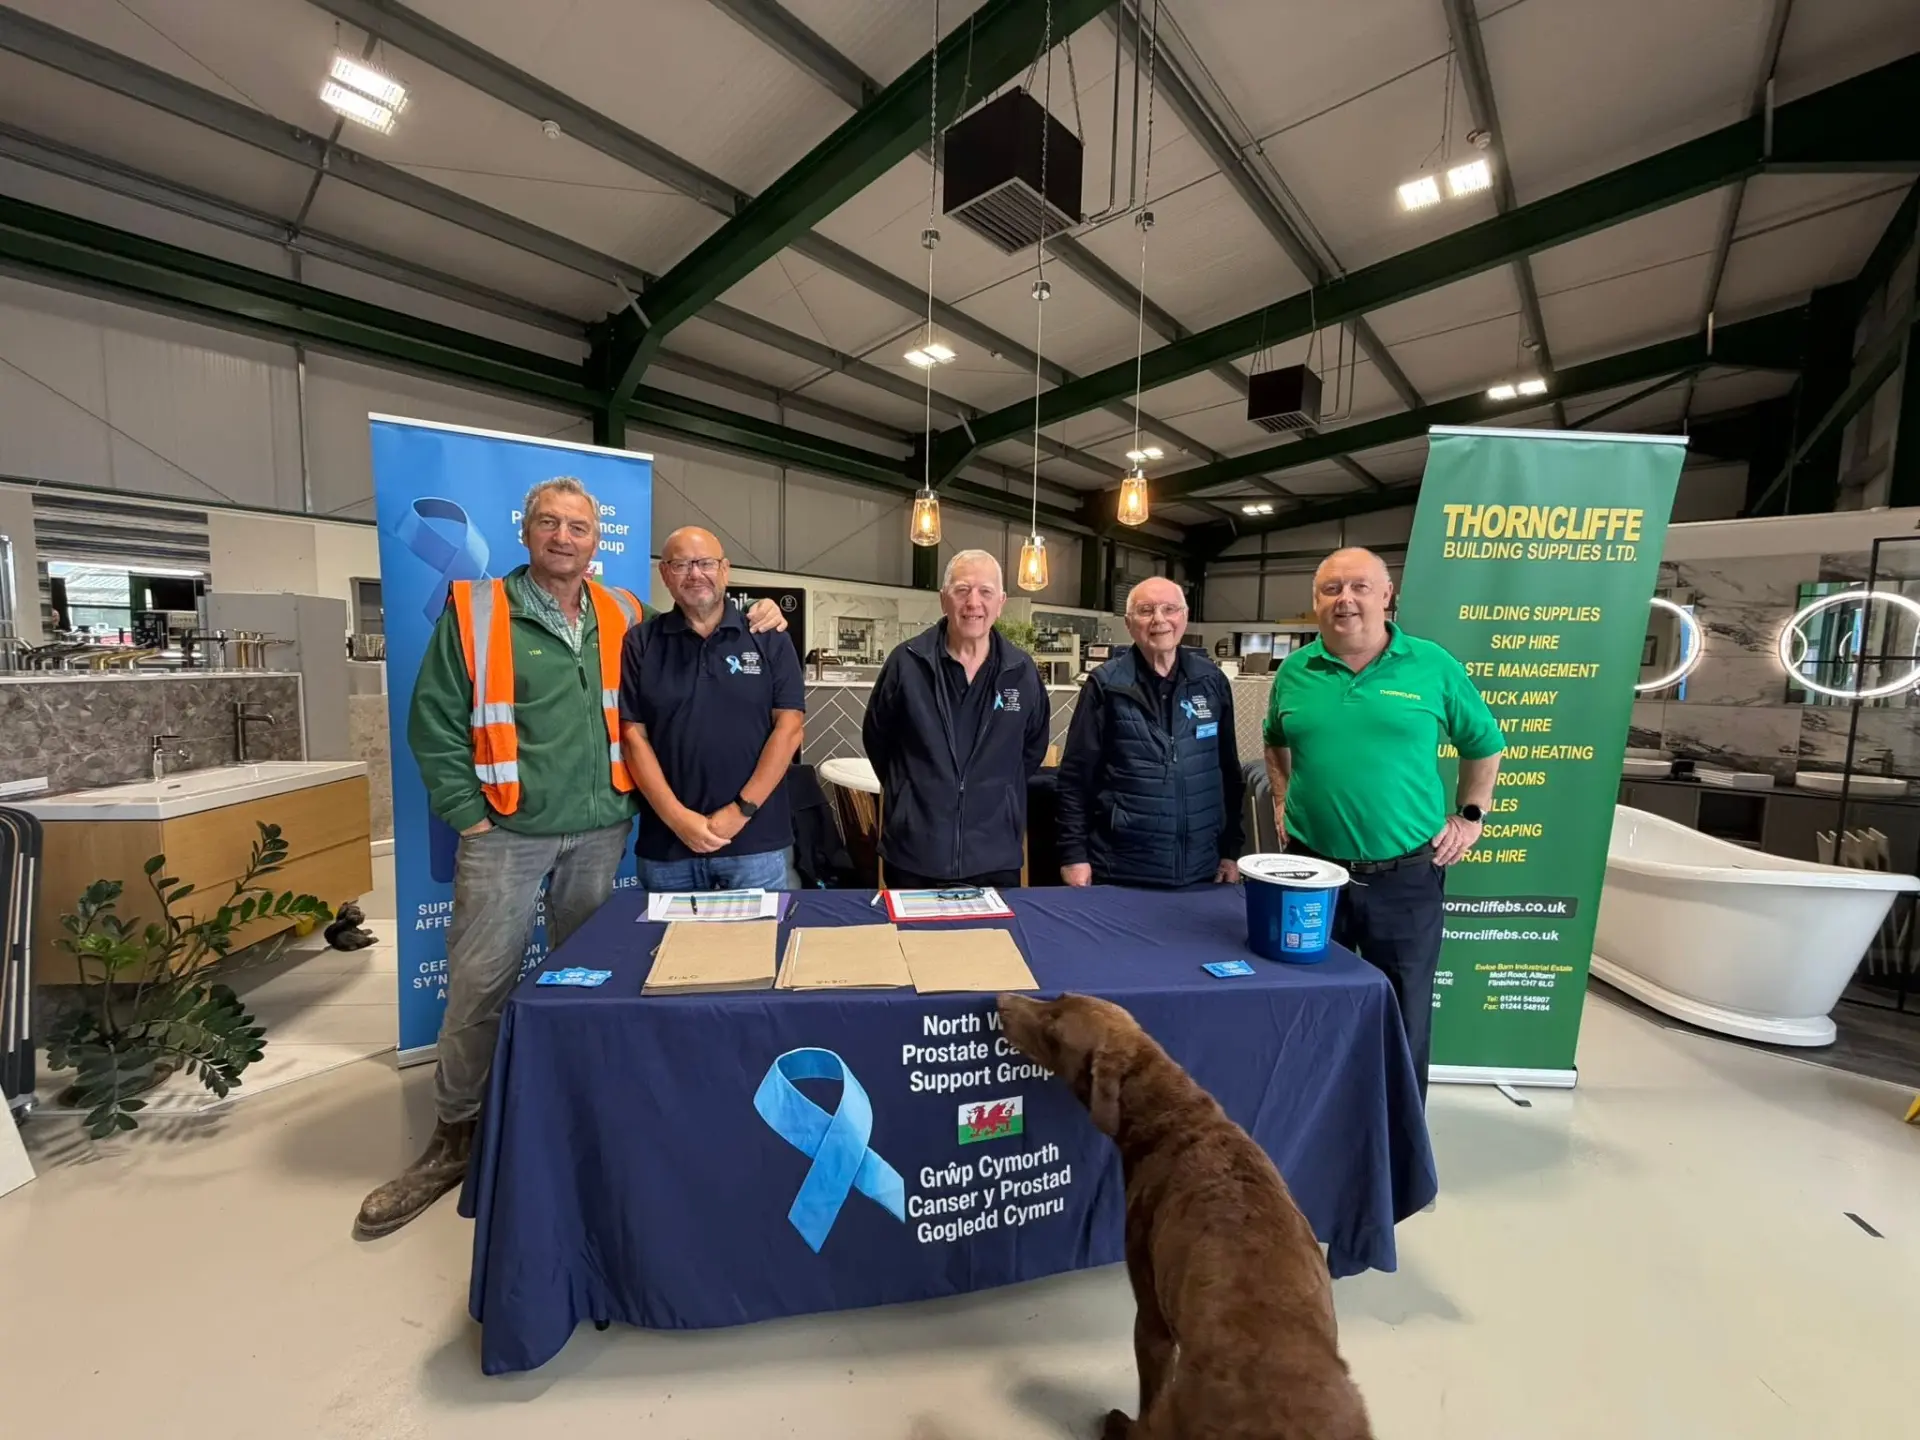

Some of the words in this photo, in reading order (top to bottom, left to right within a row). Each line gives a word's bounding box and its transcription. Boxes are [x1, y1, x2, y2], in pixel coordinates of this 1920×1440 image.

[1443, 504, 1644, 541] THORNCLIFFE
[1443, 542, 1523, 559] BUILDING
[1527, 543, 1601, 561] SUPPLIES
[1605, 544, 1637, 562] LTD.
[1458, 605, 1530, 620] BUILDING
[1533, 606, 1601, 621] SUPPLIES
[1491, 634, 1526, 649] SKIP
[1529, 635, 1560, 650] HIRE
[1498, 663, 1599, 678] MANAGEMENT
[1520, 690, 1558, 705] AWAY
[1521, 718, 1552, 733] HIRE
[1531, 745, 1593, 760] HEATING
[1461, 849, 1492, 863] RAB
[1496, 849, 1527, 862] HIRE
[1550, 964, 1573, 972] Estate
[1488, 979, 1519, 987] Flintshire
[923, 1013, 980, 1036] North
[902, 1040, 989, 1065] Prostate
[910, 1066, 991, 1093] Support
[920, 1161, 973, 1188] Grŵp
[979, 1142, 1059, 1180] Cymorth
[908, 1190, 978, 1218] Canser
[984, 1187, 995, 1209] y
[1000, 1164, 1071, 1200] Prostad
[917, 1208, 999, 1243] Gogledd
[1004, 1197, 1064, 1226] Cymru
